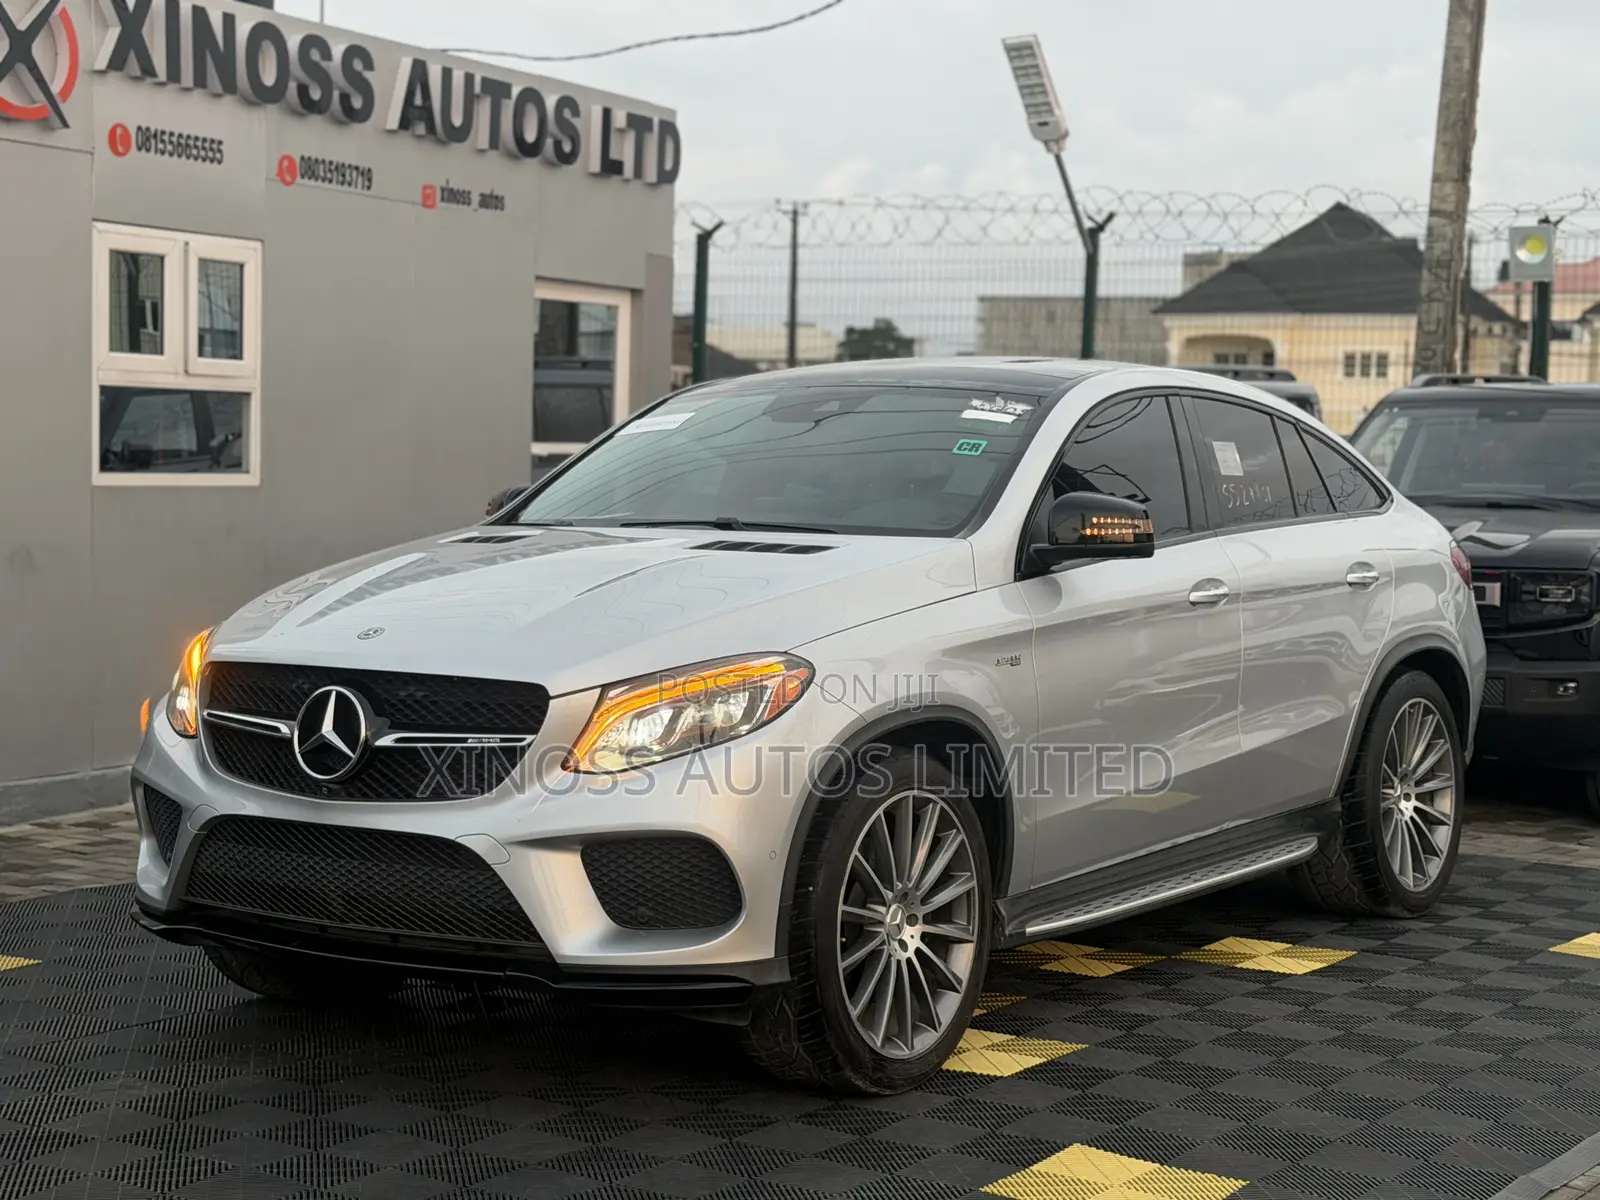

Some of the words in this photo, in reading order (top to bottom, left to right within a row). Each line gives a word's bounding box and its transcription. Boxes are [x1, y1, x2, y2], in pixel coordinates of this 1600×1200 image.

[95, 0, 376, 123] XINOSS
[388, 57, 581, 165] AUTOS
[592, 105, 681, 184] LTD
[135, 124, 224, 165] 08155665555
[299, 154, 373, 191] 08035193719
[956, 441, 983, 453] CR
